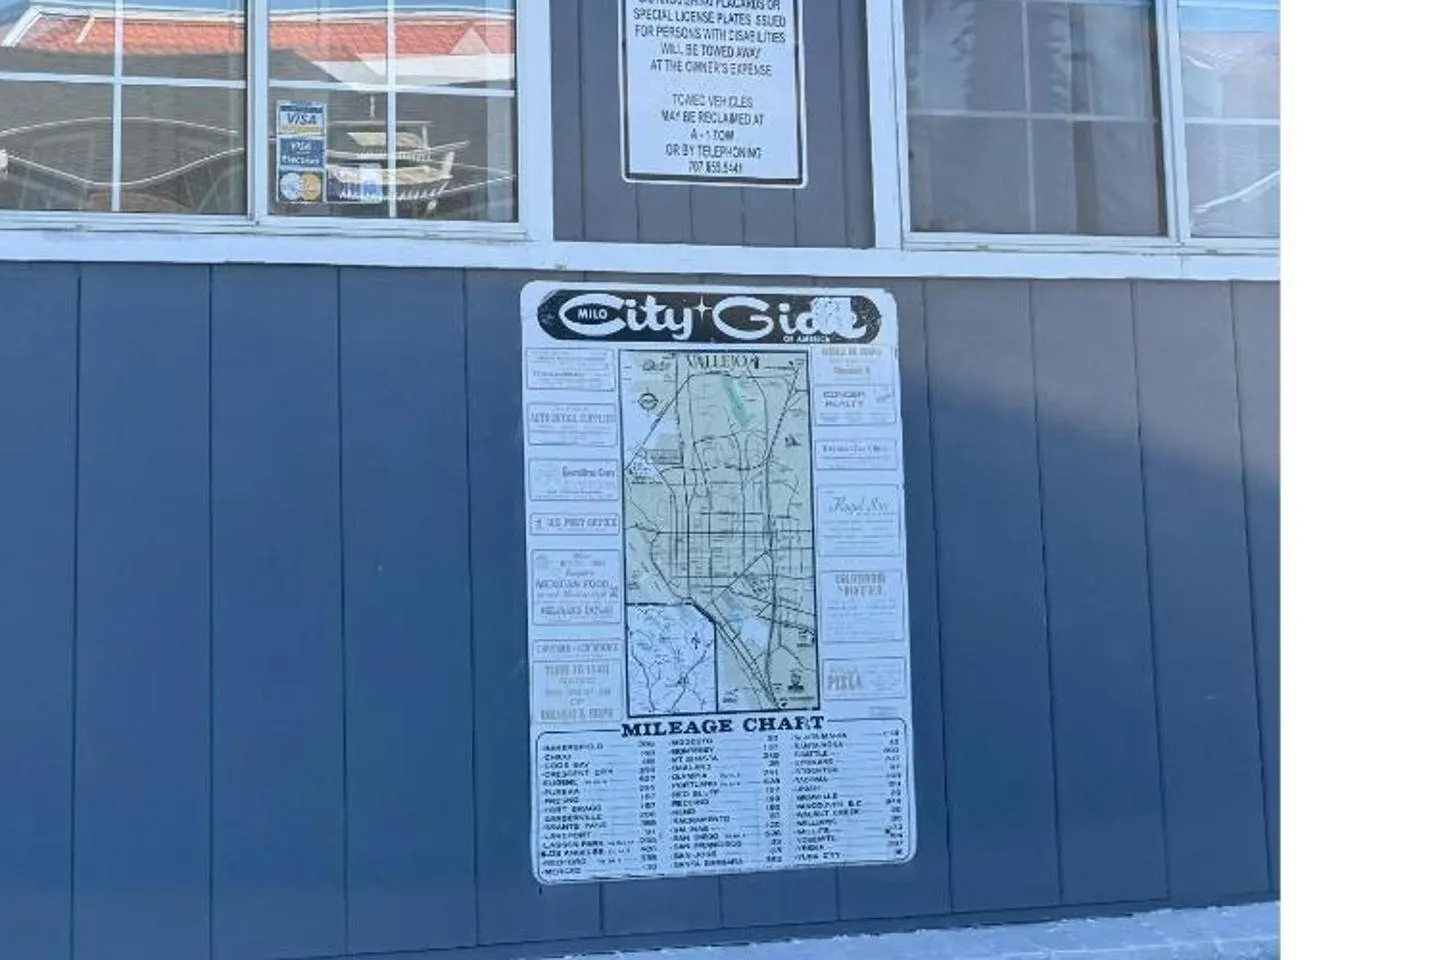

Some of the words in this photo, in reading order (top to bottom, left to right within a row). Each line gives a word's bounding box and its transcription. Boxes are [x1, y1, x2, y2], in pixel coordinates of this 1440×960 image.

[633, 8, 674, 22] SPECIAL
[675, 11, 715, 24] LICENSE
[718, 13, 752, 26] PLATES
[754, 14, 786, 28] SSUED
[635, 24, 653, 38] FOR
[656, 26, 701, 39] PERSONS
[703, 28, 726, 41] WITH
[728, 29, 786, 43] DISABILITIES
[661, 43, 683, 55] WILL
[686, 44, 699, 57] BE
[702, 45, 734, 58] TOWED
[735, 47, 762, 59] AWAY
[650, 59, 662, 71] AT
[665, 60, 683, 73] THE
[685, 61, 729, 75] OWNER'S
[730, 63, 772, 77] EXPENSE
[672, 93, 705, 106] TOWED
[708, 95, 753, 108] VEHICLES
[286, 112, 318, 126] VISA
[661, 110, 681, 122] MAY
[683, 111, 695, 123] BE
[698, 111, 750, 126] RECLAIMED
[751, 114, 764, 125] AT
[712, 129, 735, 141] TOW
[665, 144, 680, 156] OR
[682, 144, 694, 157] BY
[558, 293, 694, 341] City
[577, 308, 608, 320] MILO
[686, 354, 748, 368] VALLEJO
[621, 719, 733, 738] MILEAGE
[742, 715, 825, 733] CHART
